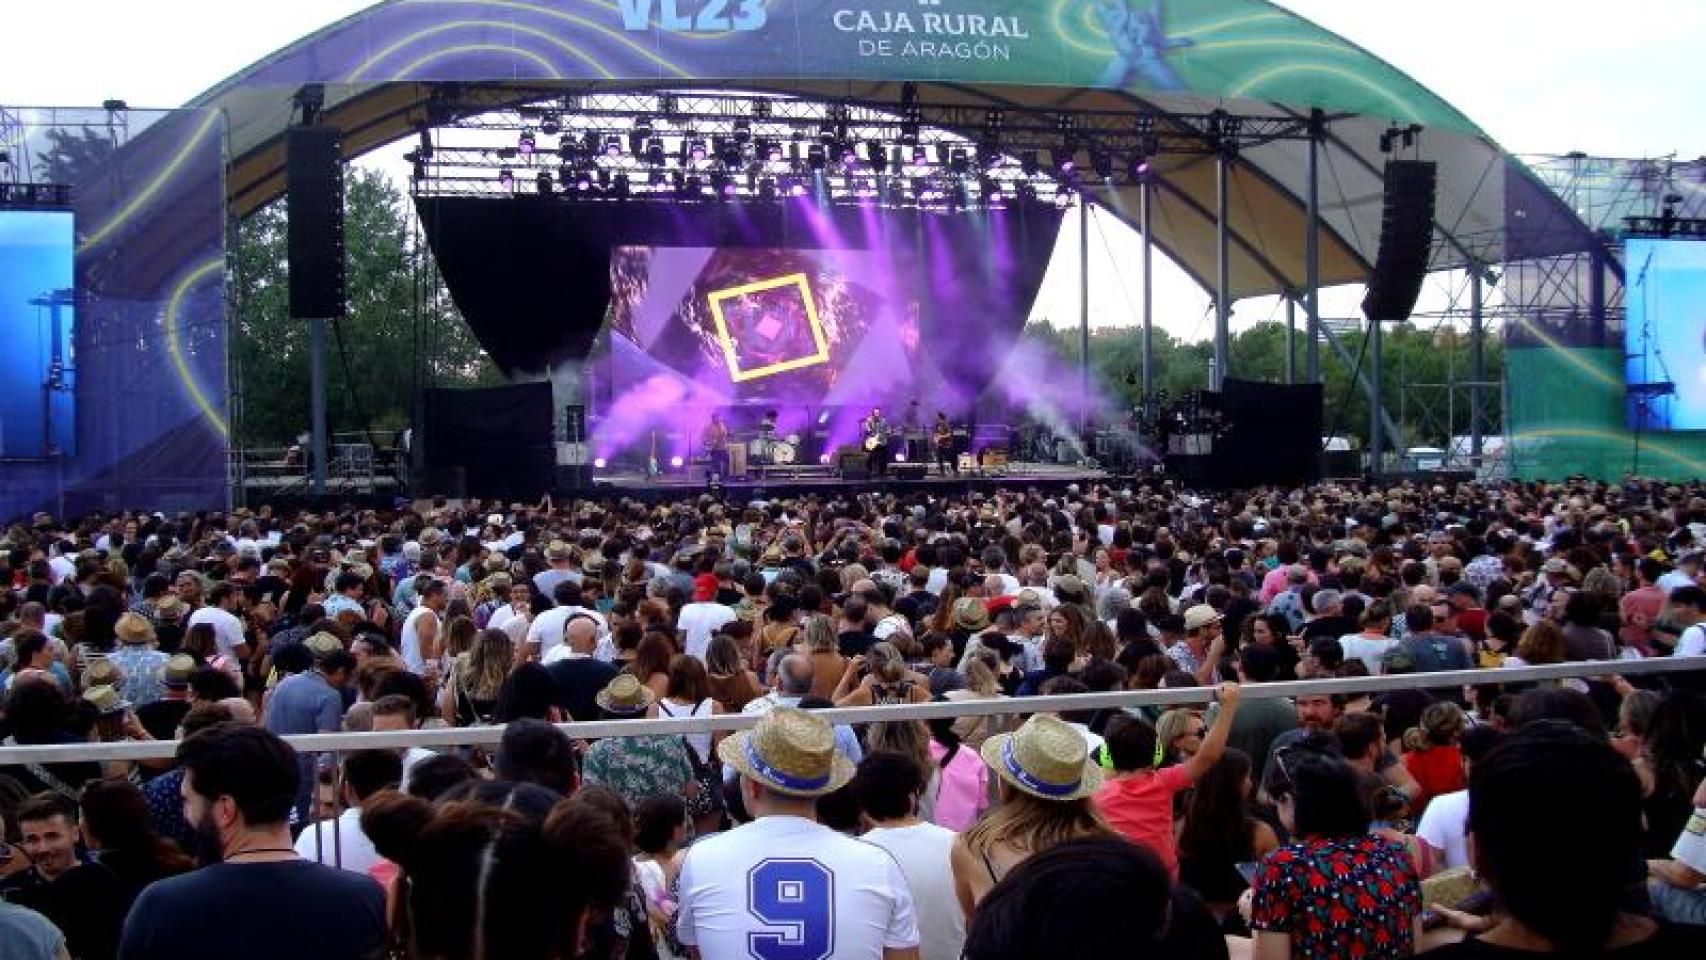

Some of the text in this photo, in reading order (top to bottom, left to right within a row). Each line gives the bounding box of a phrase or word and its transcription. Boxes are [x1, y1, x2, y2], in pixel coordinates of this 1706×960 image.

[618, 0, 767, 30] VL23
[833, 10, 1029, 38] CAJA RURAL
[859, 40, 1009, 60] DE ARAGÓN
[746, 857, 836, 960] 9
